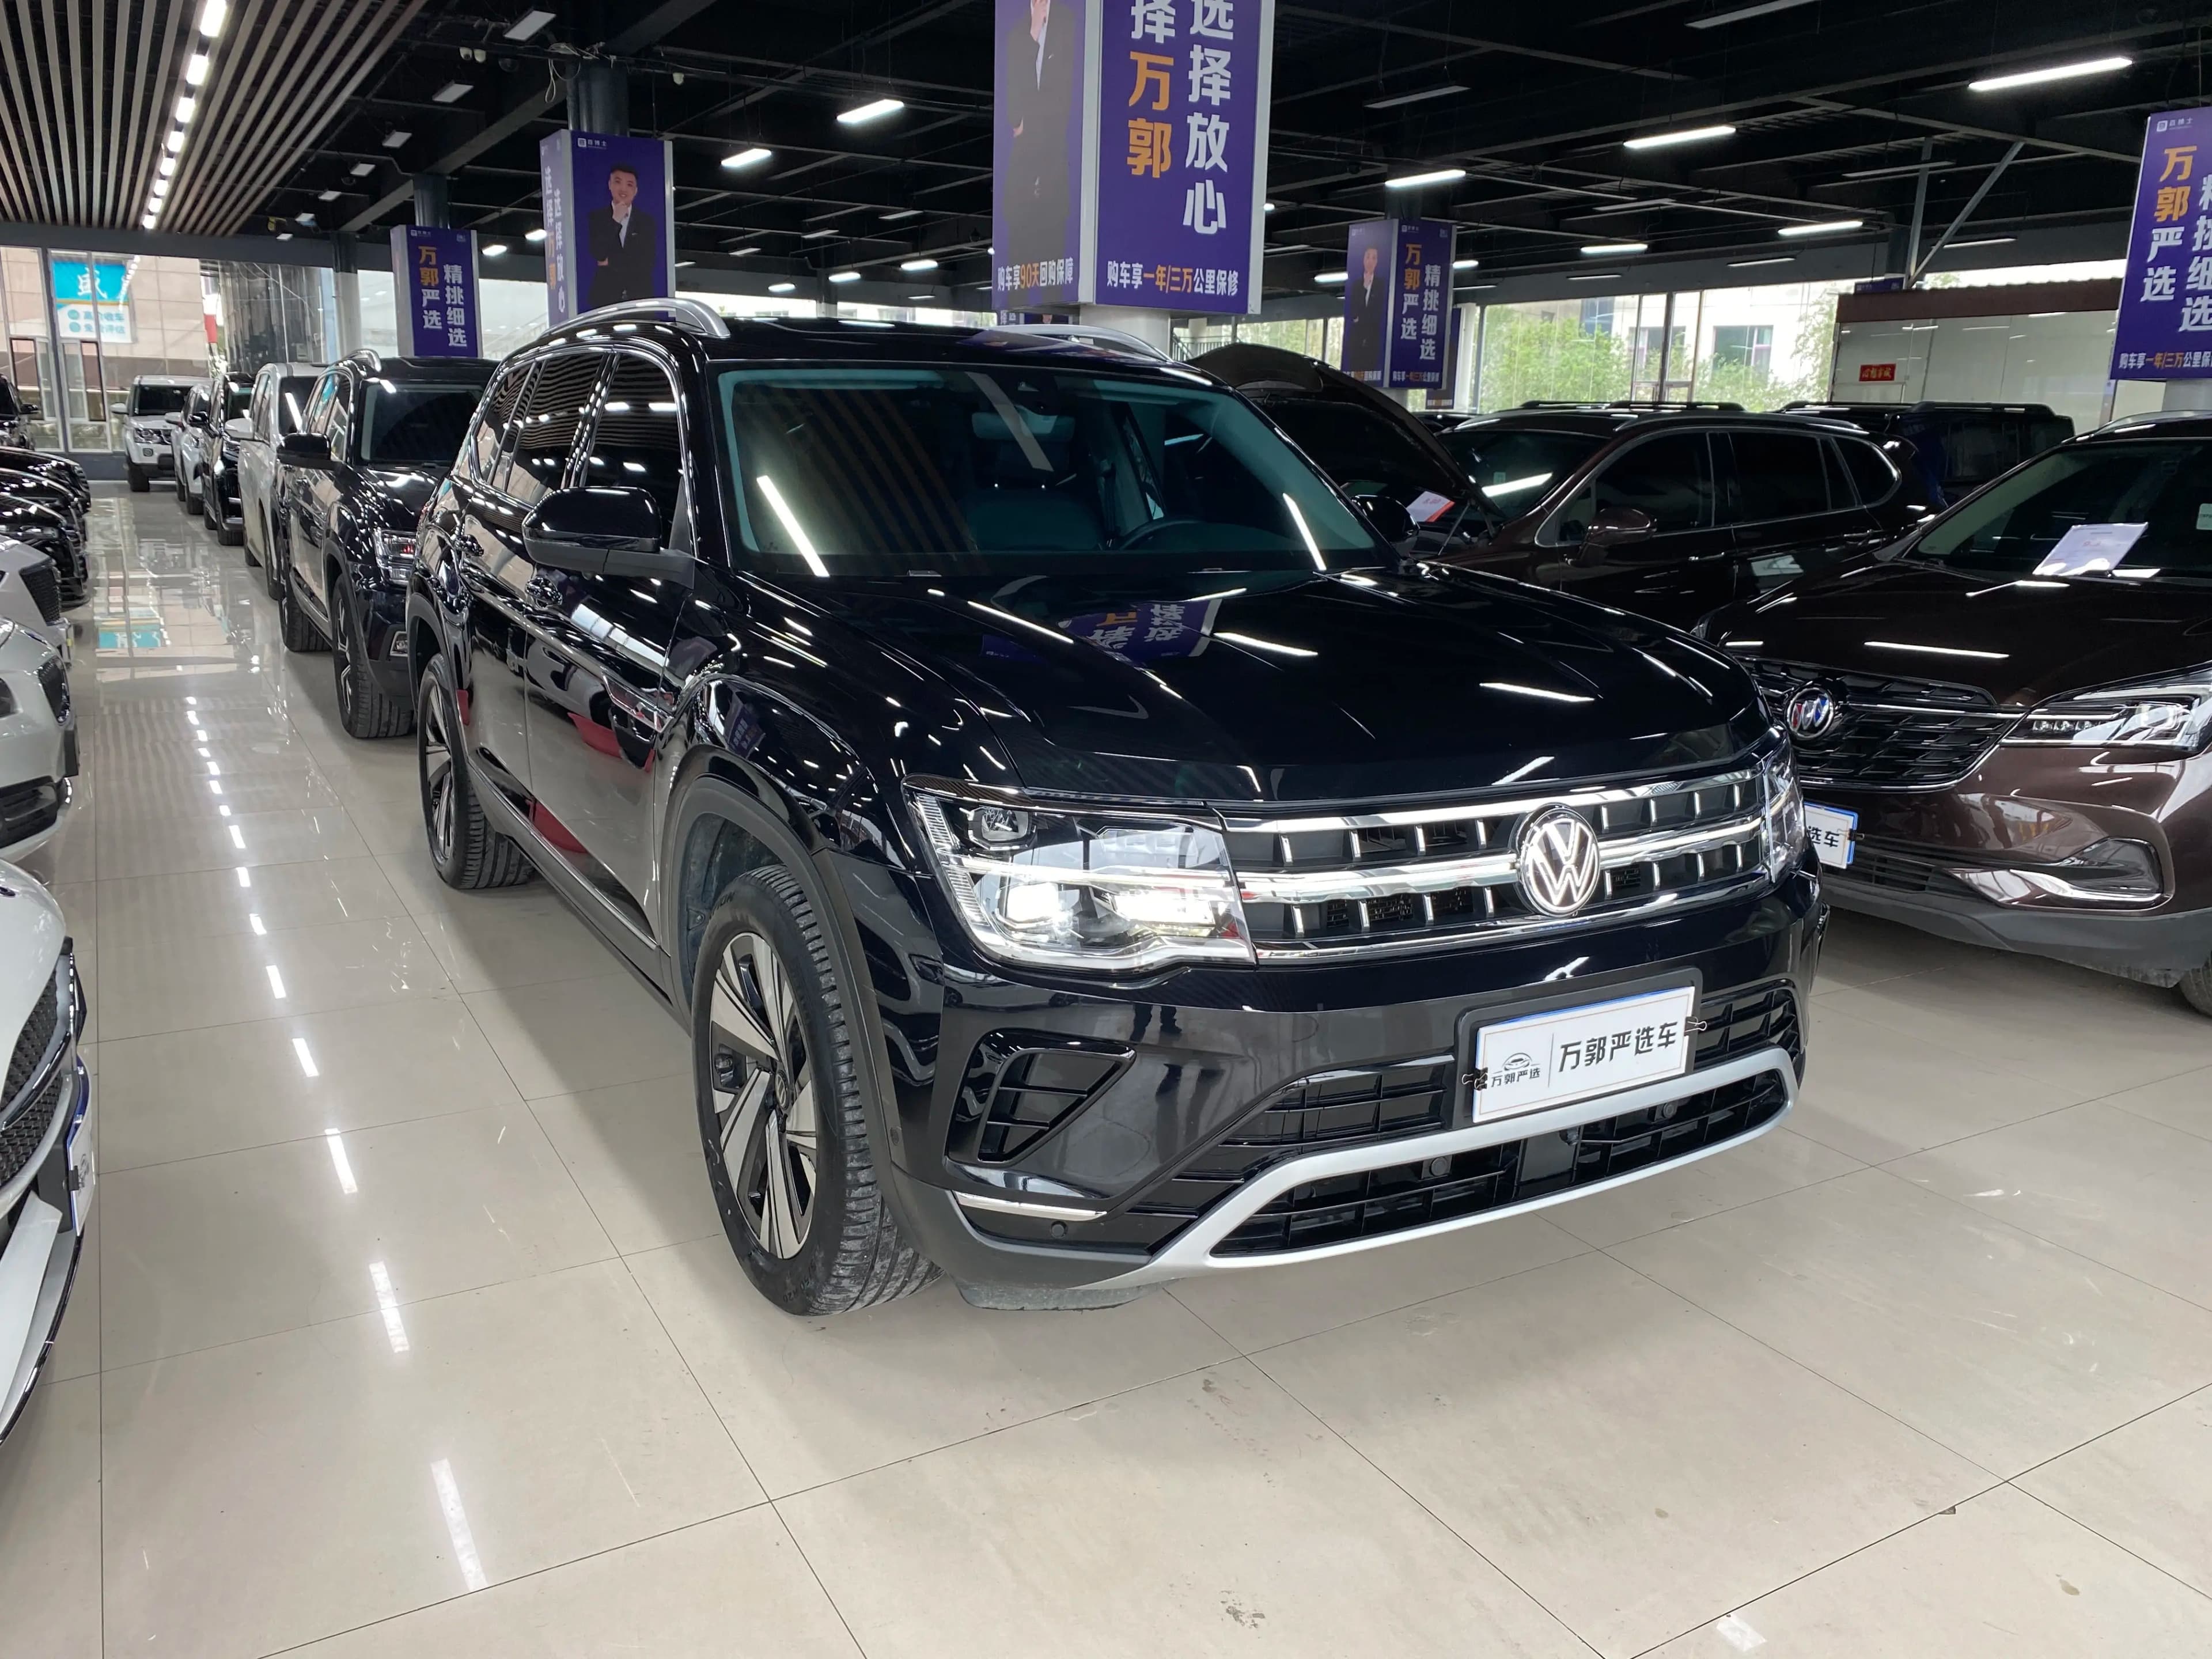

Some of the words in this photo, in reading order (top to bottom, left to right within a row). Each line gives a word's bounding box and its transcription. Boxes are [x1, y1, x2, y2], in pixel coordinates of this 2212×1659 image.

[1127, 0, 1176, 178] 择万郭
[1183, 0, 1234, 234] 选择放心
[2140, 145, 2198, 302] 万郭严选
[418, 246, 442, 329] 万郭严选
[444, 264, 467, 347] 精挑细选
[997, 257, 1074, 291] 购车享90天回购保障
[1107, 260, 1238, 296] 购车享一年/三万公里保修
[1400, 243, 1422, 340] 万郭严选
[1419, 264, 1441, 360] 精挑细选
[2119, 351, 2212, 369] 购车享一年/三万公里保
[1491, 1067, 1541, 1088] 万郭严选
[1558, 1021, 1678, 1073] 万郭严选车
